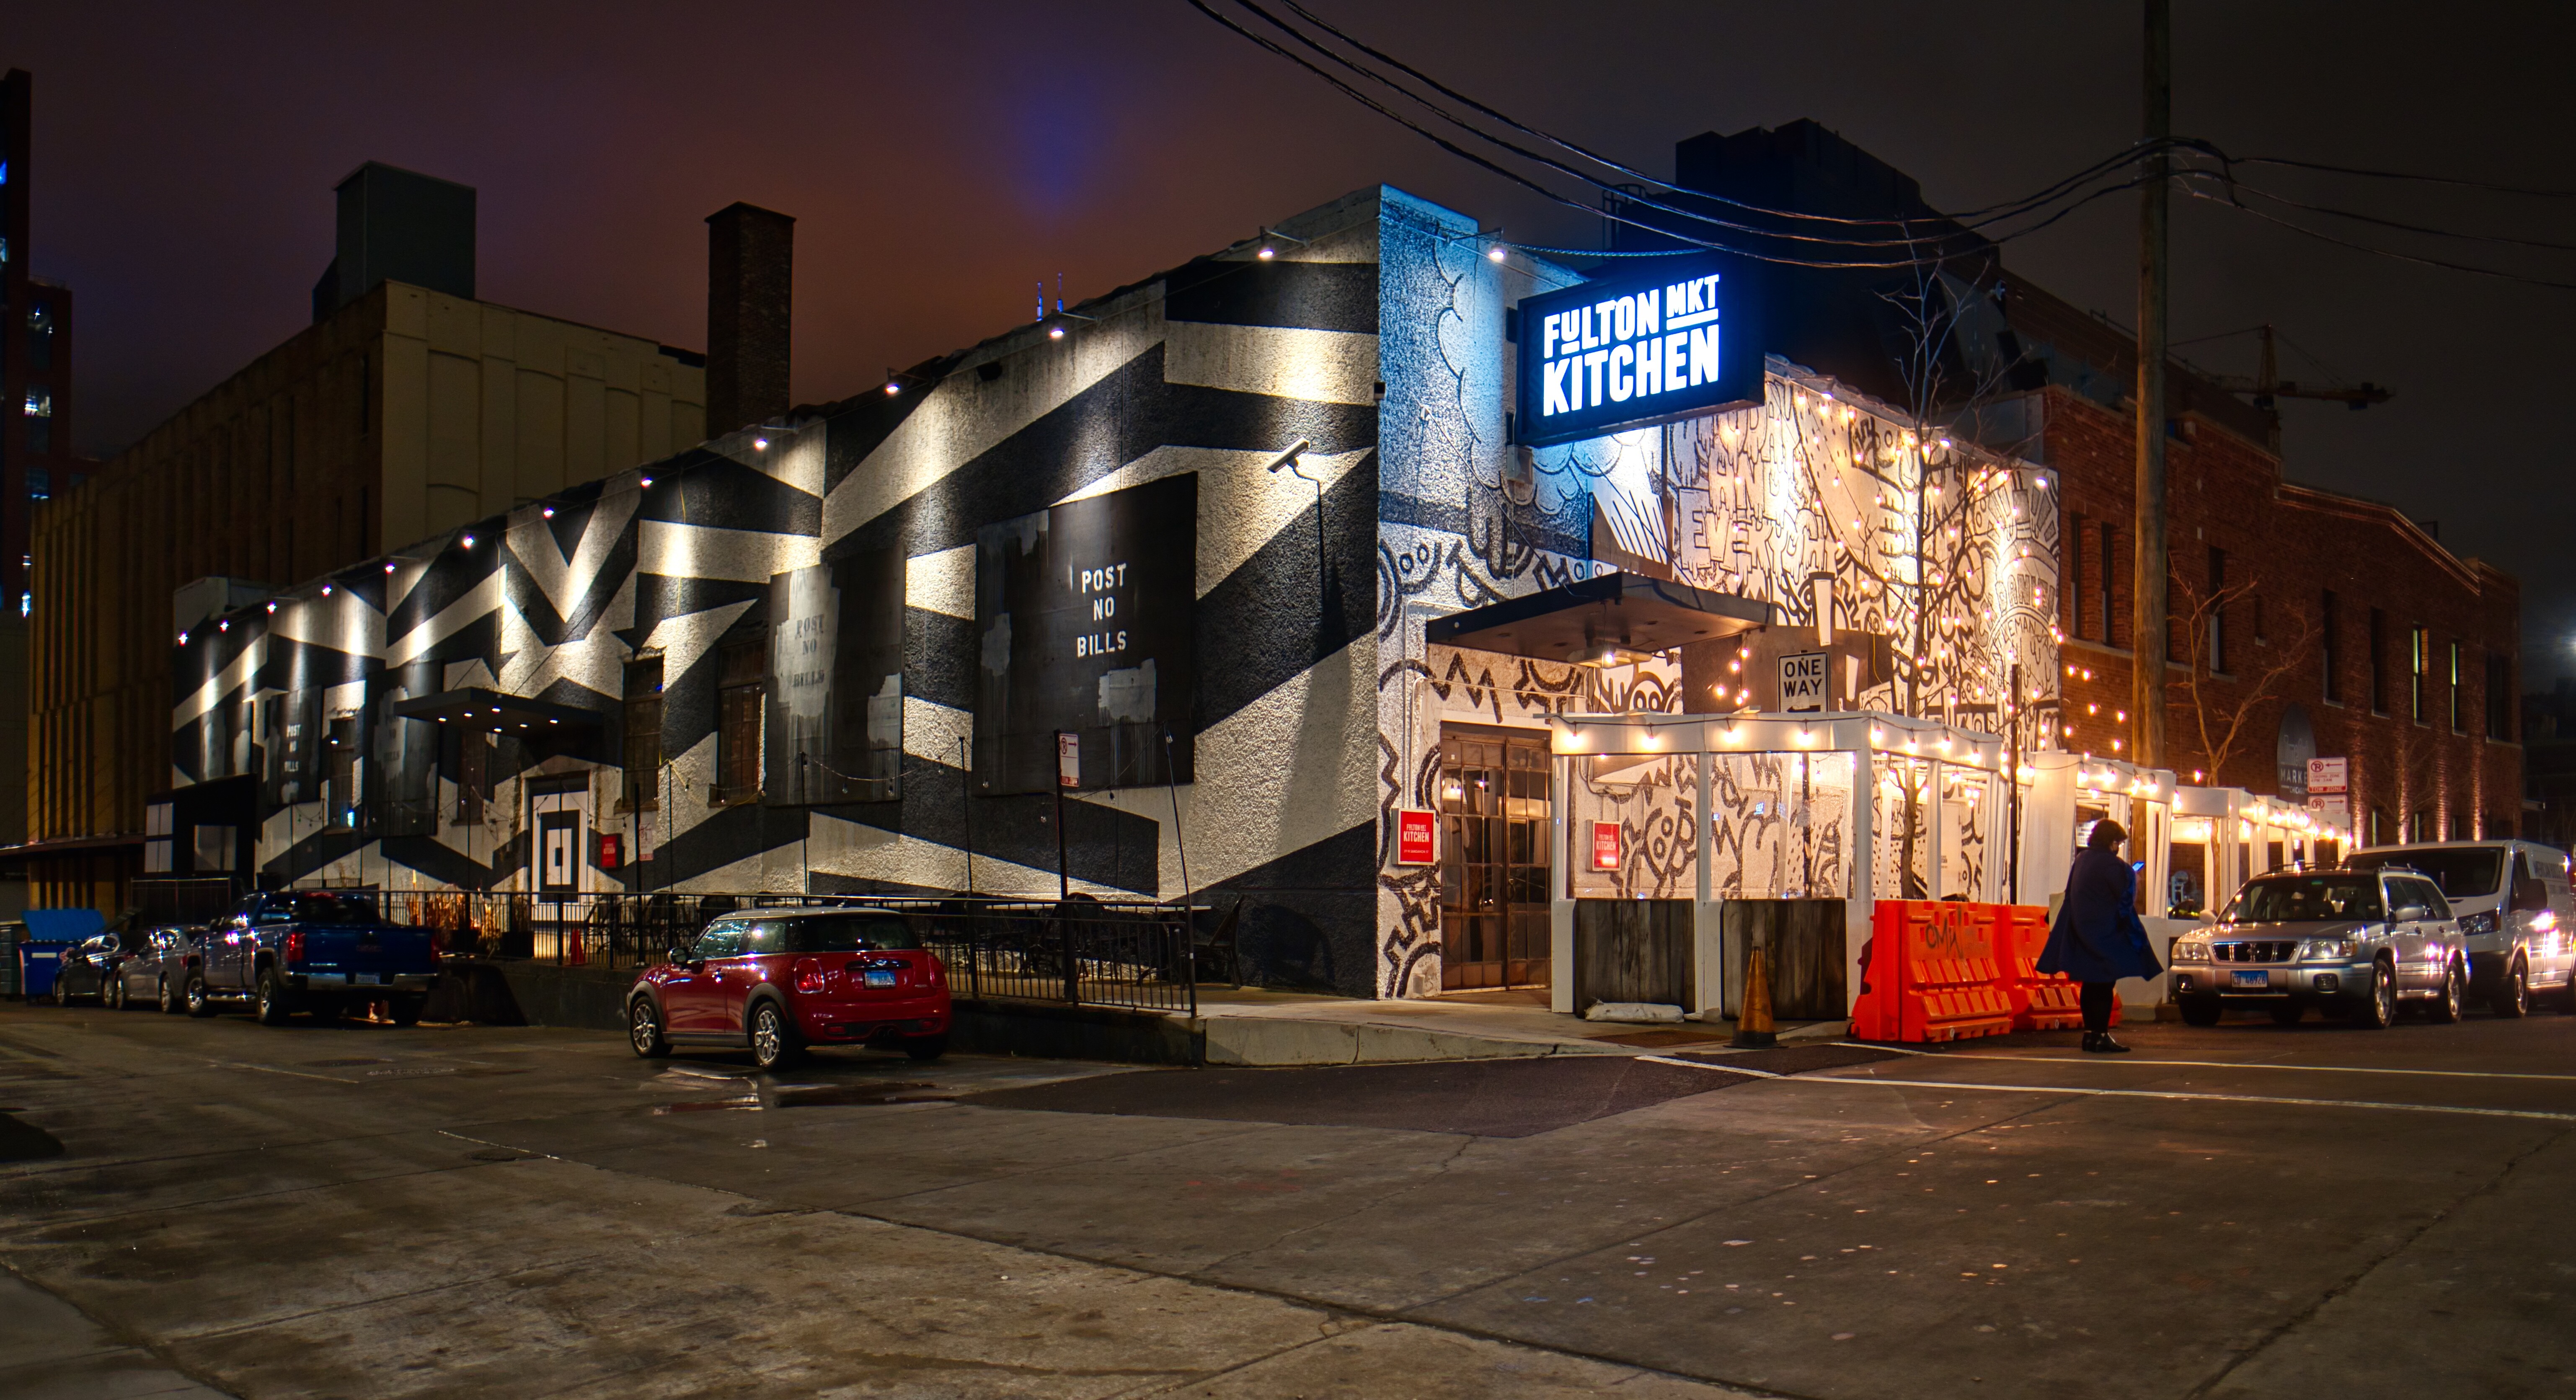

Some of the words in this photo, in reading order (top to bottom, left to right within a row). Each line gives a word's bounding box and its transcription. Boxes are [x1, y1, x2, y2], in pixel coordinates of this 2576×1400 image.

[1544, 289, 1659, 359] FULTON
[1666, 274, 1719, 318] MKT
[1543, 324, 1719, 416] KITCHEN
[1082, 563, 1127, 593] POST
[1093, 597, 1115, 621] NO
[796, 614, 824, 635] POST
[803, 638, 817, 655] NO
[1077, 630, 1127, 657] BILLS
[1785, 659, 1821, 677] ONE
[793, 670, 824, 687] BILLS
[1784, 678, 1822, 697] WAY
[2280, 768, 2307, 785] MARKE
[1403, 831, 1429, 842] KITCHEN
[1596, 840, 1616, 851] KITCHEN
